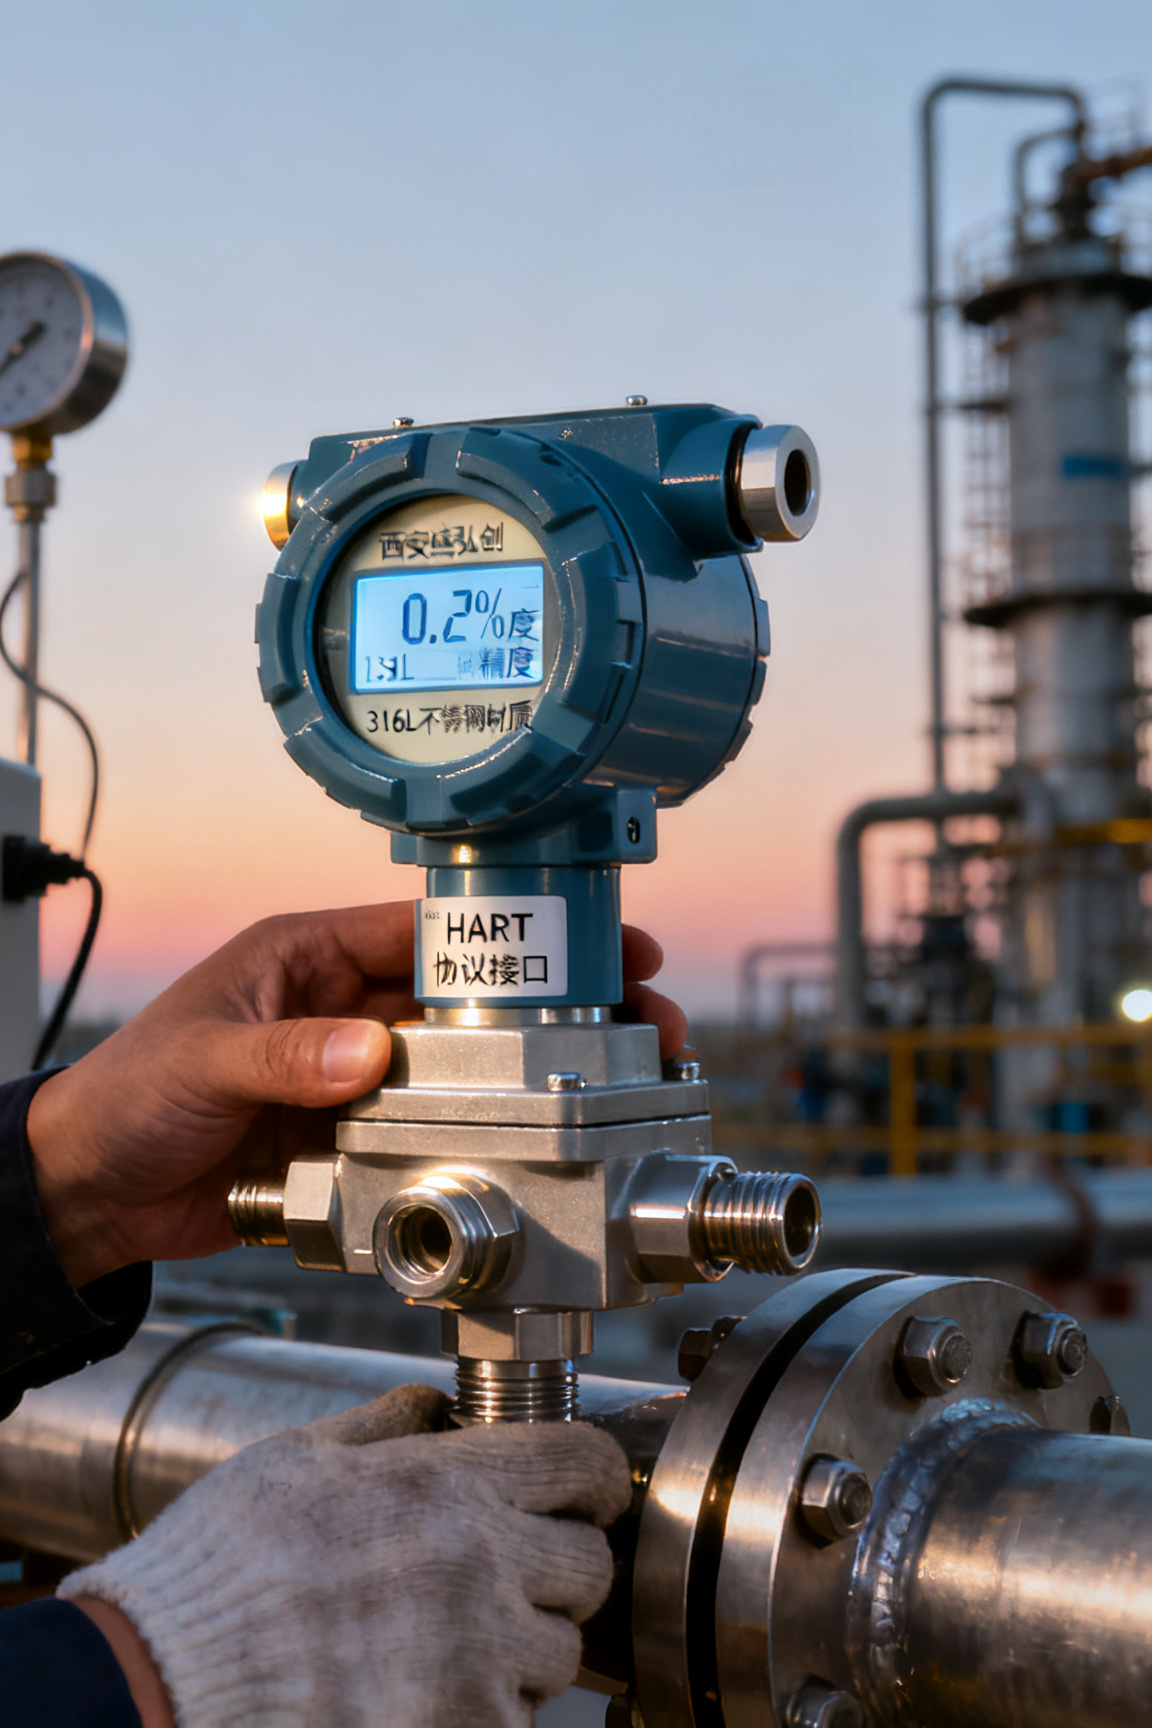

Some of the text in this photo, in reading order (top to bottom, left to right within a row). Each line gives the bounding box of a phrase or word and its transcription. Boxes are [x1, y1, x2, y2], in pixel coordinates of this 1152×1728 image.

[447, 912, 533, 945] HART
[433, 951, 548, 988] 协议接口
